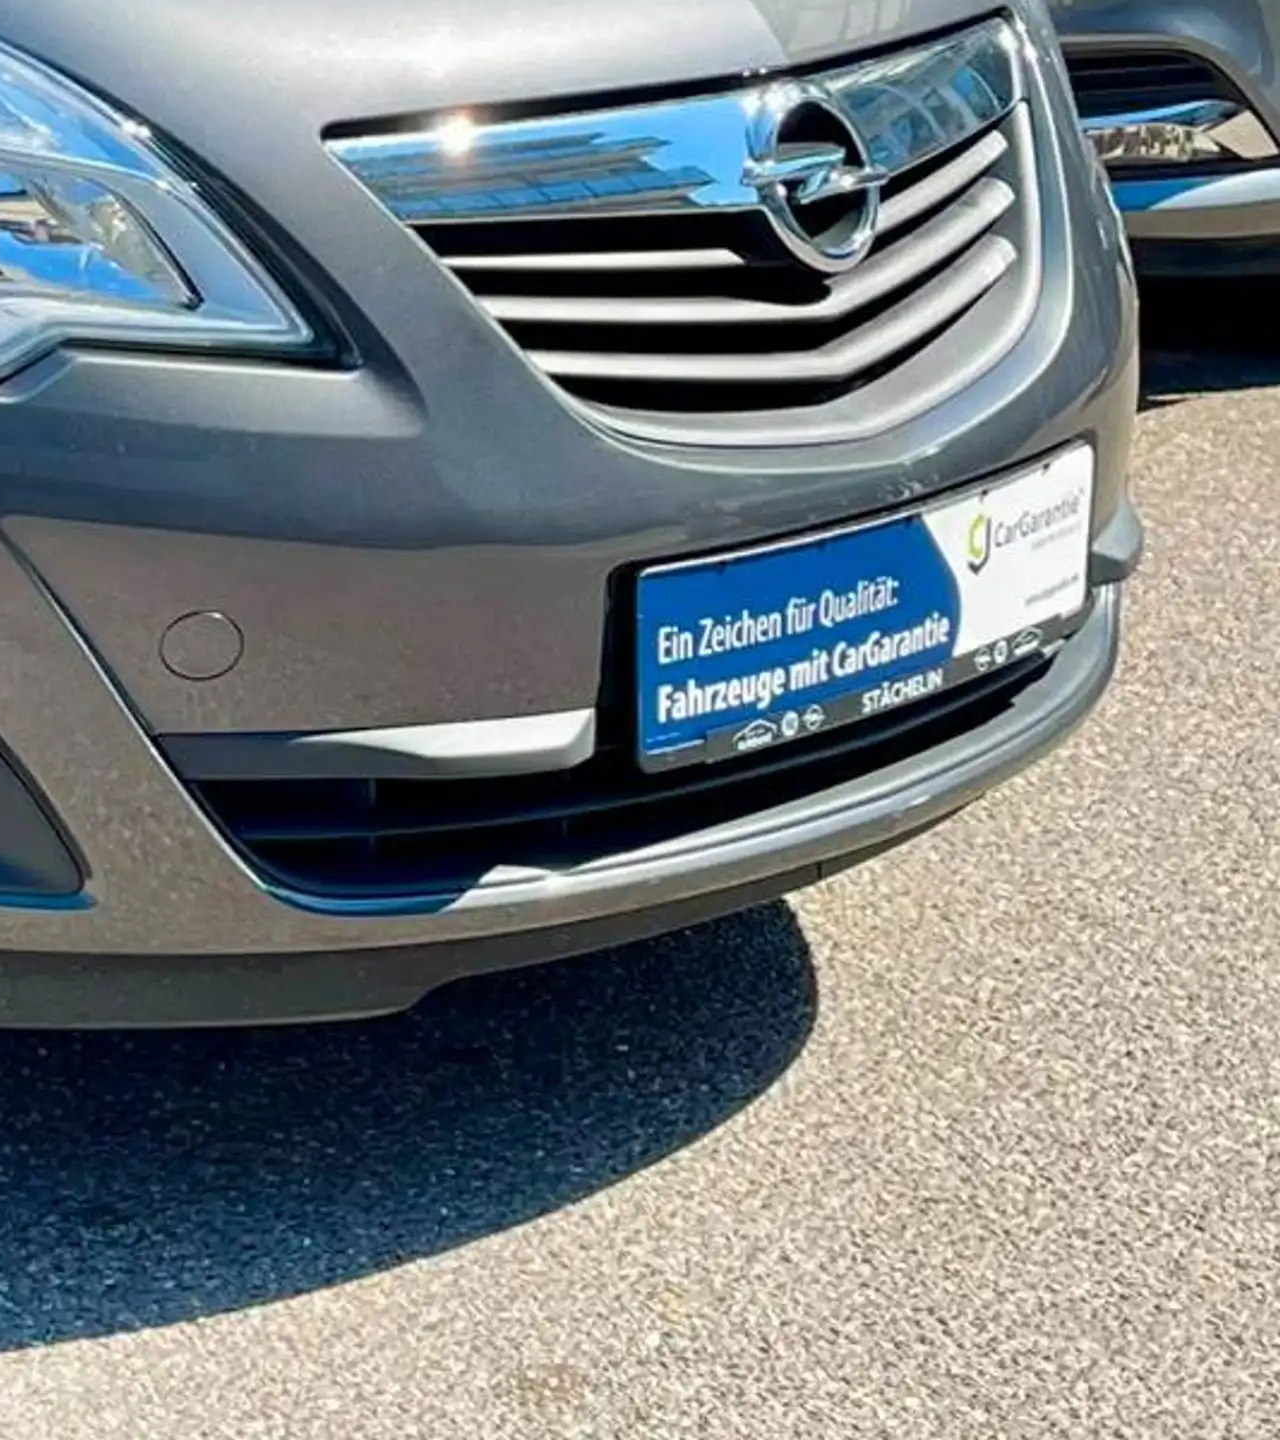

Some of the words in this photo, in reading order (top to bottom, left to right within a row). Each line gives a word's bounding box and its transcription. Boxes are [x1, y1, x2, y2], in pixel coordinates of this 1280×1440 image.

[657, 625, 693, 664] Ein
[698, 609, 782, 657] Zeichen
[786, 597, 817, 635] für
[819, 575, 900, 627] Qualität:
[657, 666, 787, 723] Fahrzeuge
[790, 650, 831, 692] mit
[831, 611, 951, 678] CarGarantie
